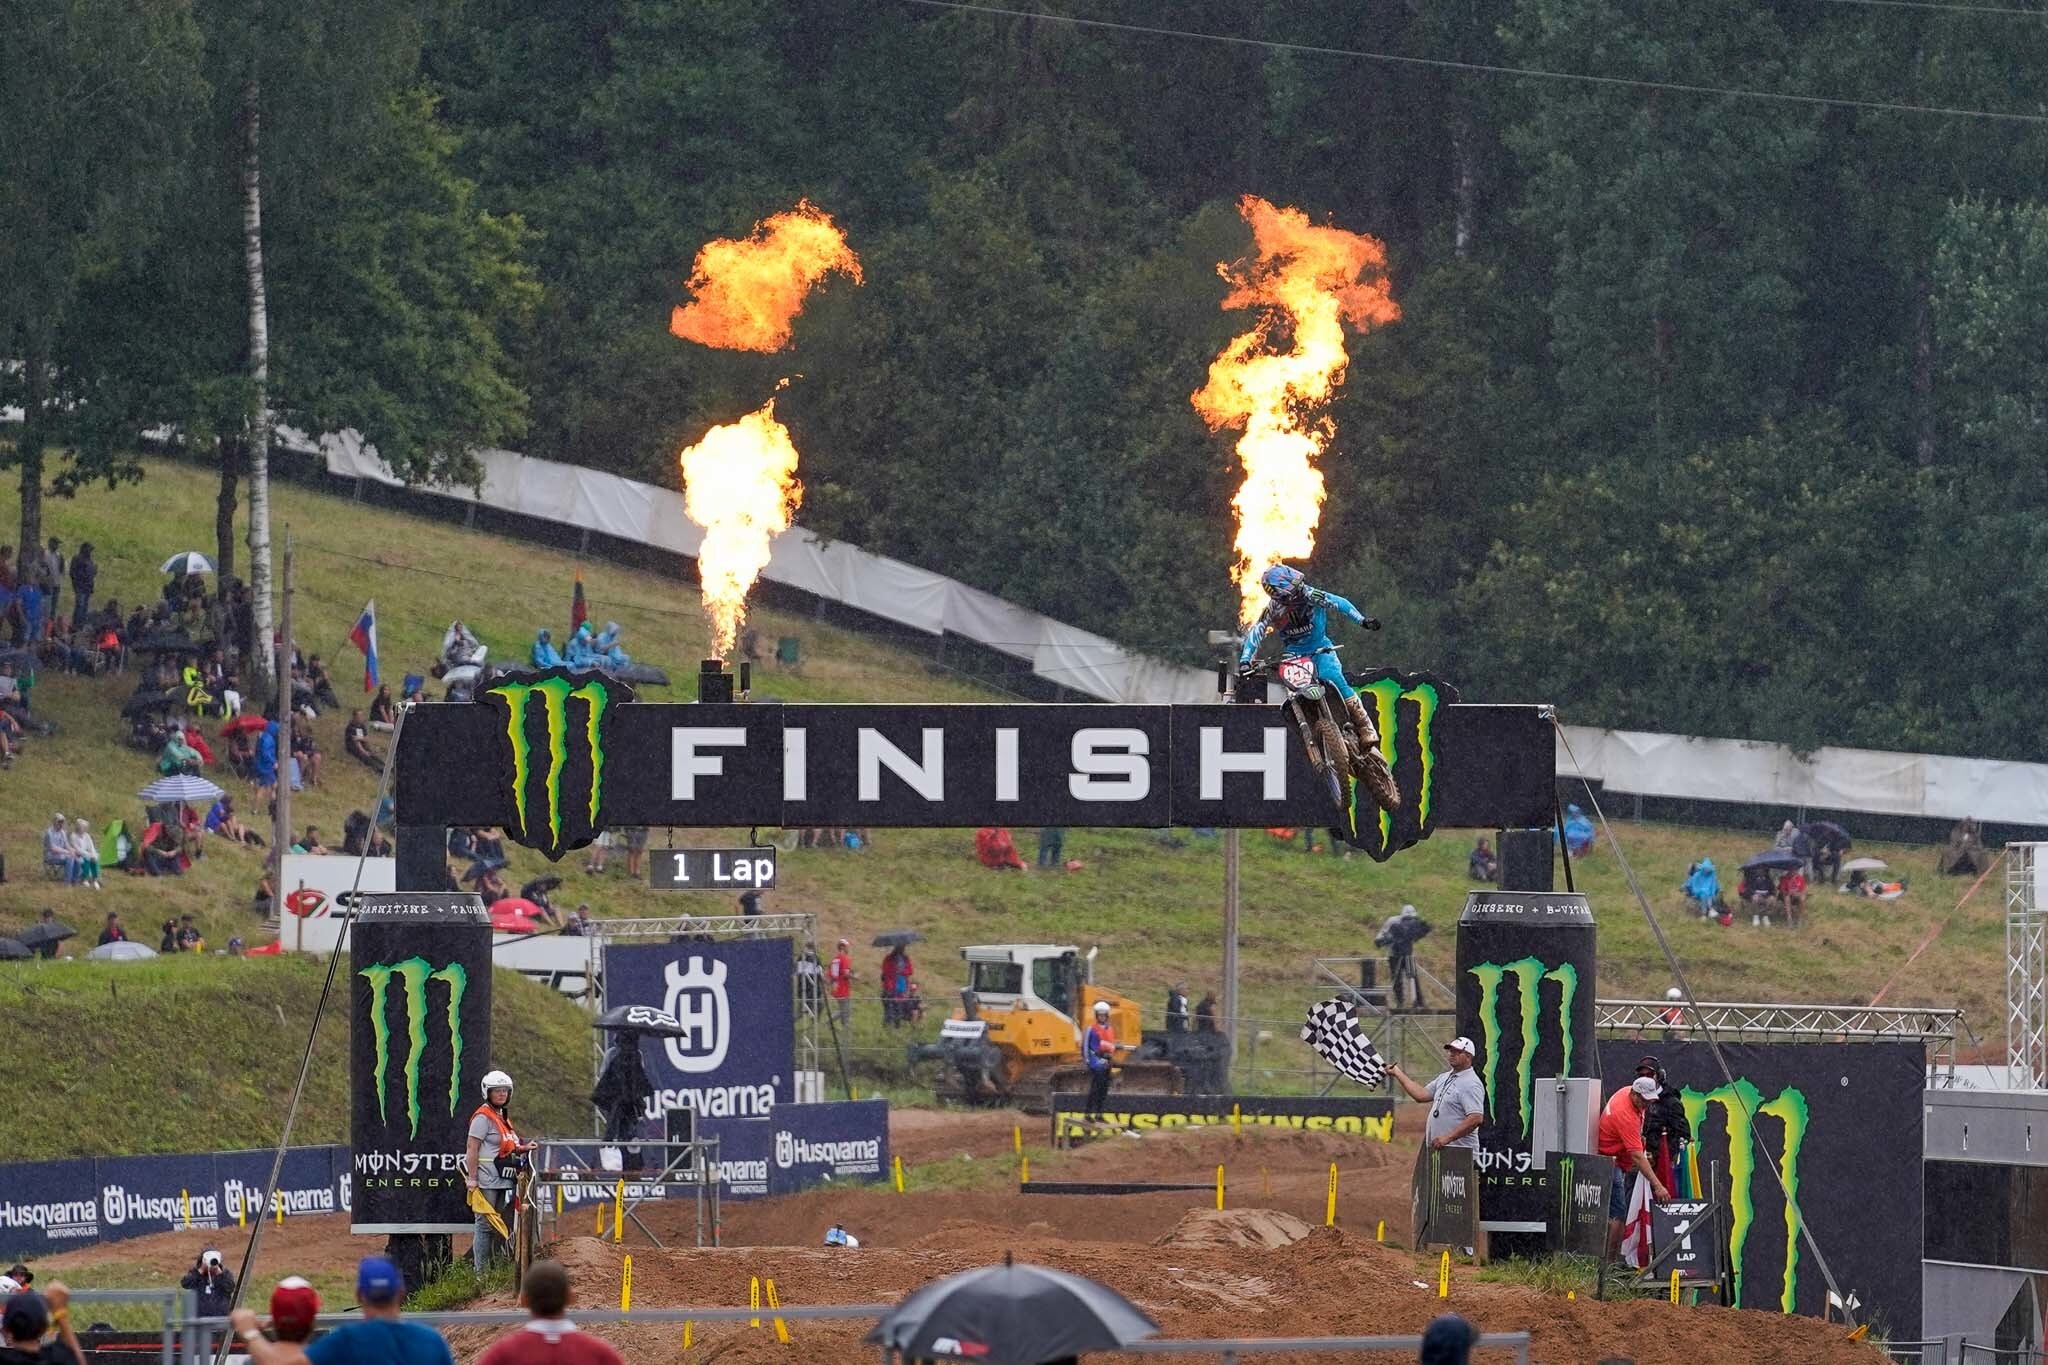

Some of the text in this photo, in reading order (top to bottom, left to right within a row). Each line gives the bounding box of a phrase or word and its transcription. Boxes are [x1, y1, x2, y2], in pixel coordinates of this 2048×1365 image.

[1286, 623, 1314, 636] YAMAHA
[671, 727, 1287, 801] FINISH
[673, 853, 774, 888] 1 Lap
[1471, 904, 1524, 914] GINSENG
[643, 1084, 776, 1120] usqvarna
[355, 1149, 469, 1176] MONSTER
[794, 1138, 878, 1166] Husqvarna
[366, 1178, 454, 1188] ENERGY
[1575, 1179, 1602, 1208] MONSTER
[0, 1199, 97, 1229] Husqvarna
[47, 1225, 98, 1239] MOTORCYCLES
[1674, 1220, 1692, 1250] 1
[1677, 1253, 1696, 1261] LAP
